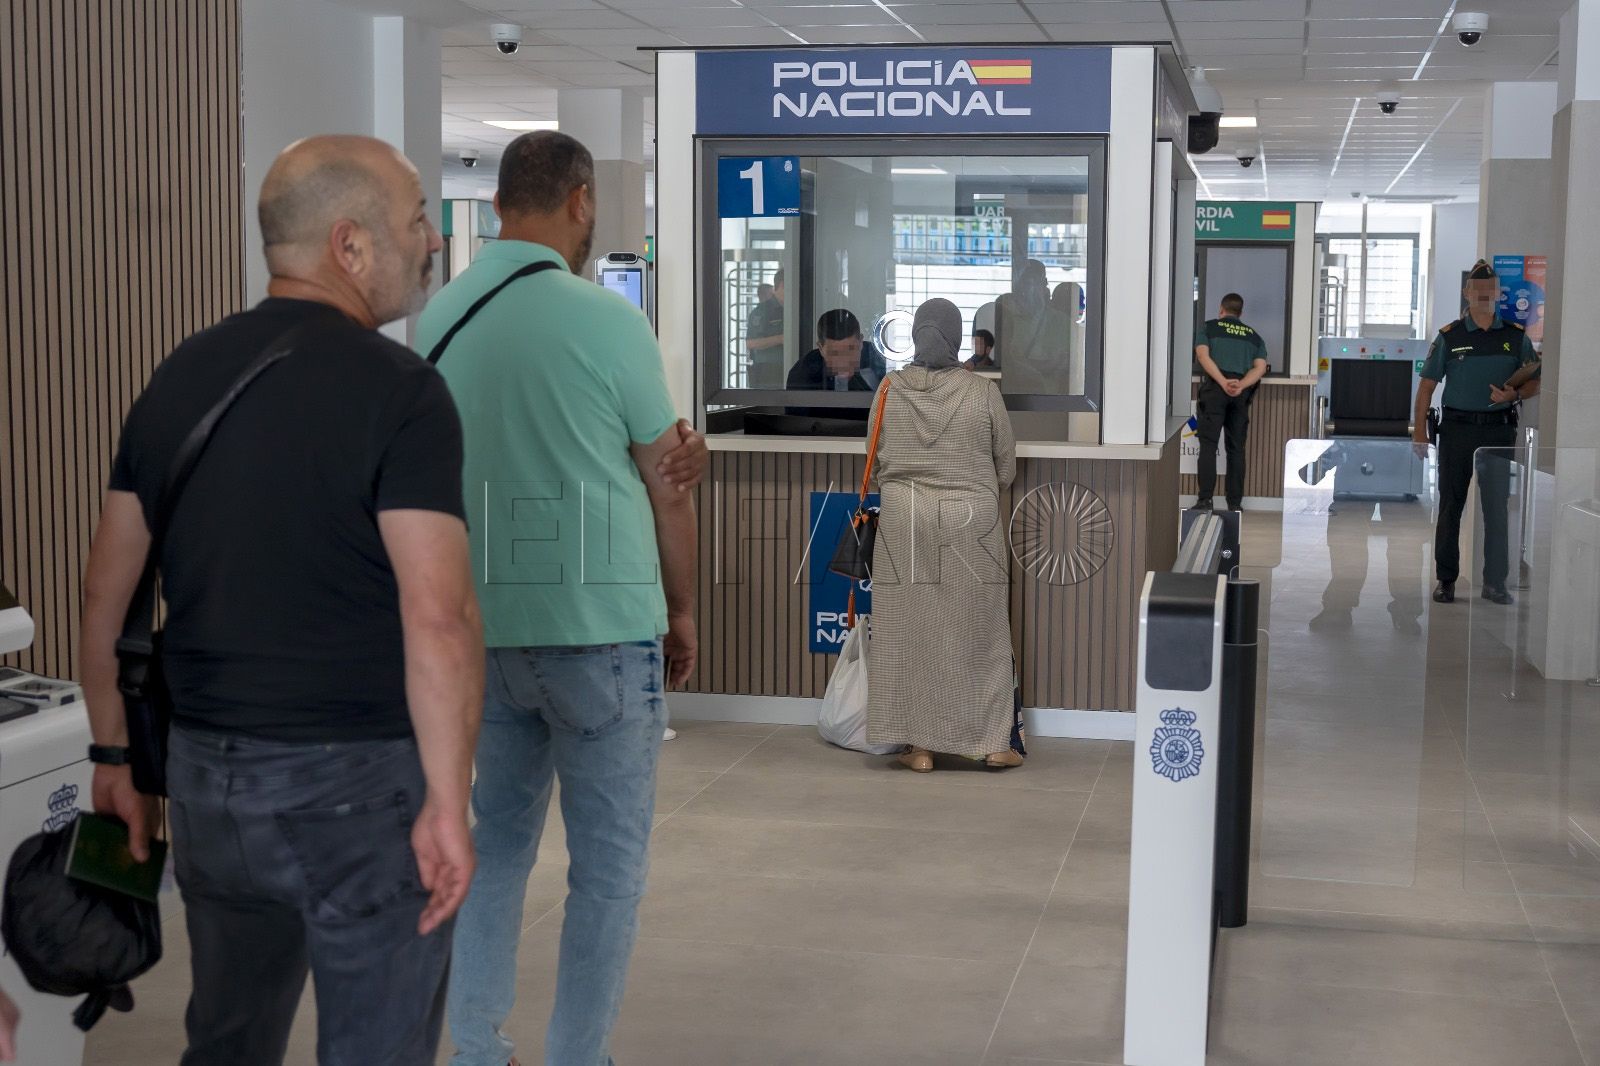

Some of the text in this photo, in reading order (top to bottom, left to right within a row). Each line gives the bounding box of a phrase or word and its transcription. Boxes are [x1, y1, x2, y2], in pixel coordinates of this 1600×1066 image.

[773, 60, 978, 87] POLICÍA
[773, 91, 1031, 117] NACIONAL
[740, 160, 764, 215] 1
[1196, 207, 1234, 218] RDIA
[1196, 220, 1220, 231] VIL
[1217, 321, 1254, 335] GUARDIA
[1226, 327, 1247, 336] CIVIL
